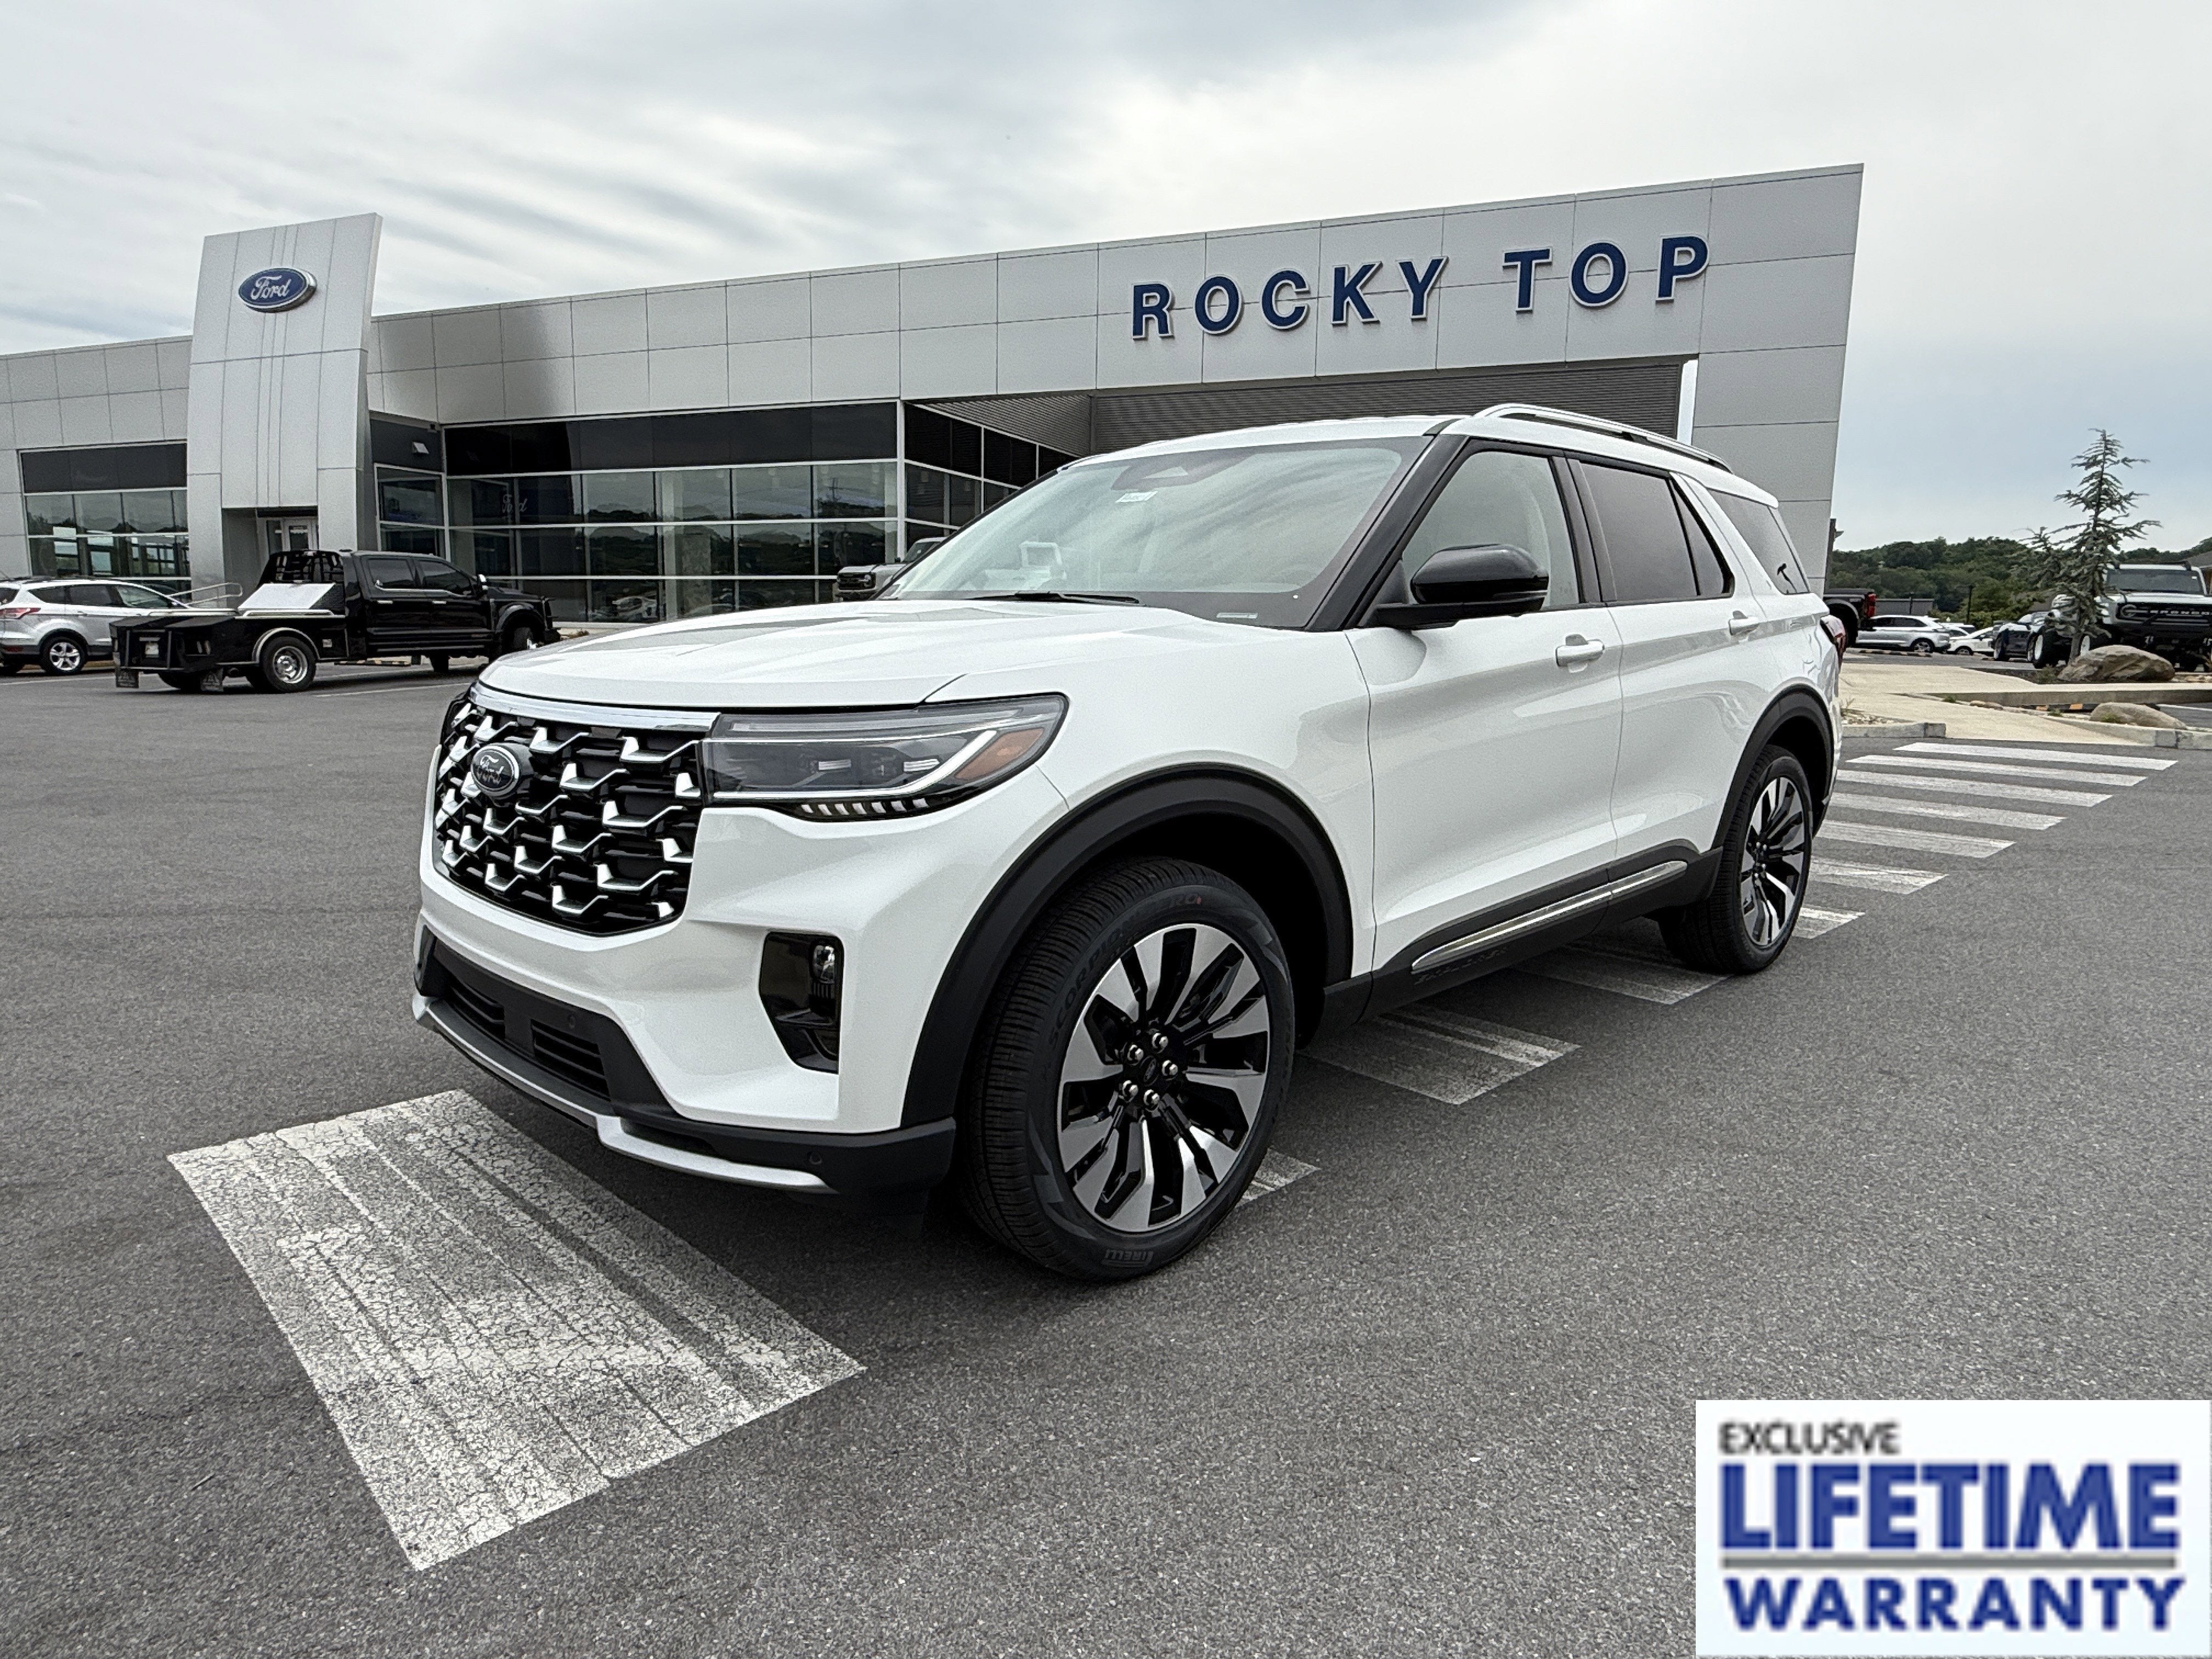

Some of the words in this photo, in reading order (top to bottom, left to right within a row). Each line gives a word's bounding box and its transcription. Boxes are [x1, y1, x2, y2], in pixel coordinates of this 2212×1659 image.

[251, 275, 292, 300] Ford
[1132, 256, 1448, 340] ROCKY
[1502, 235, 1709, 314] TOP
[476, 755, 505, 785] Ford
